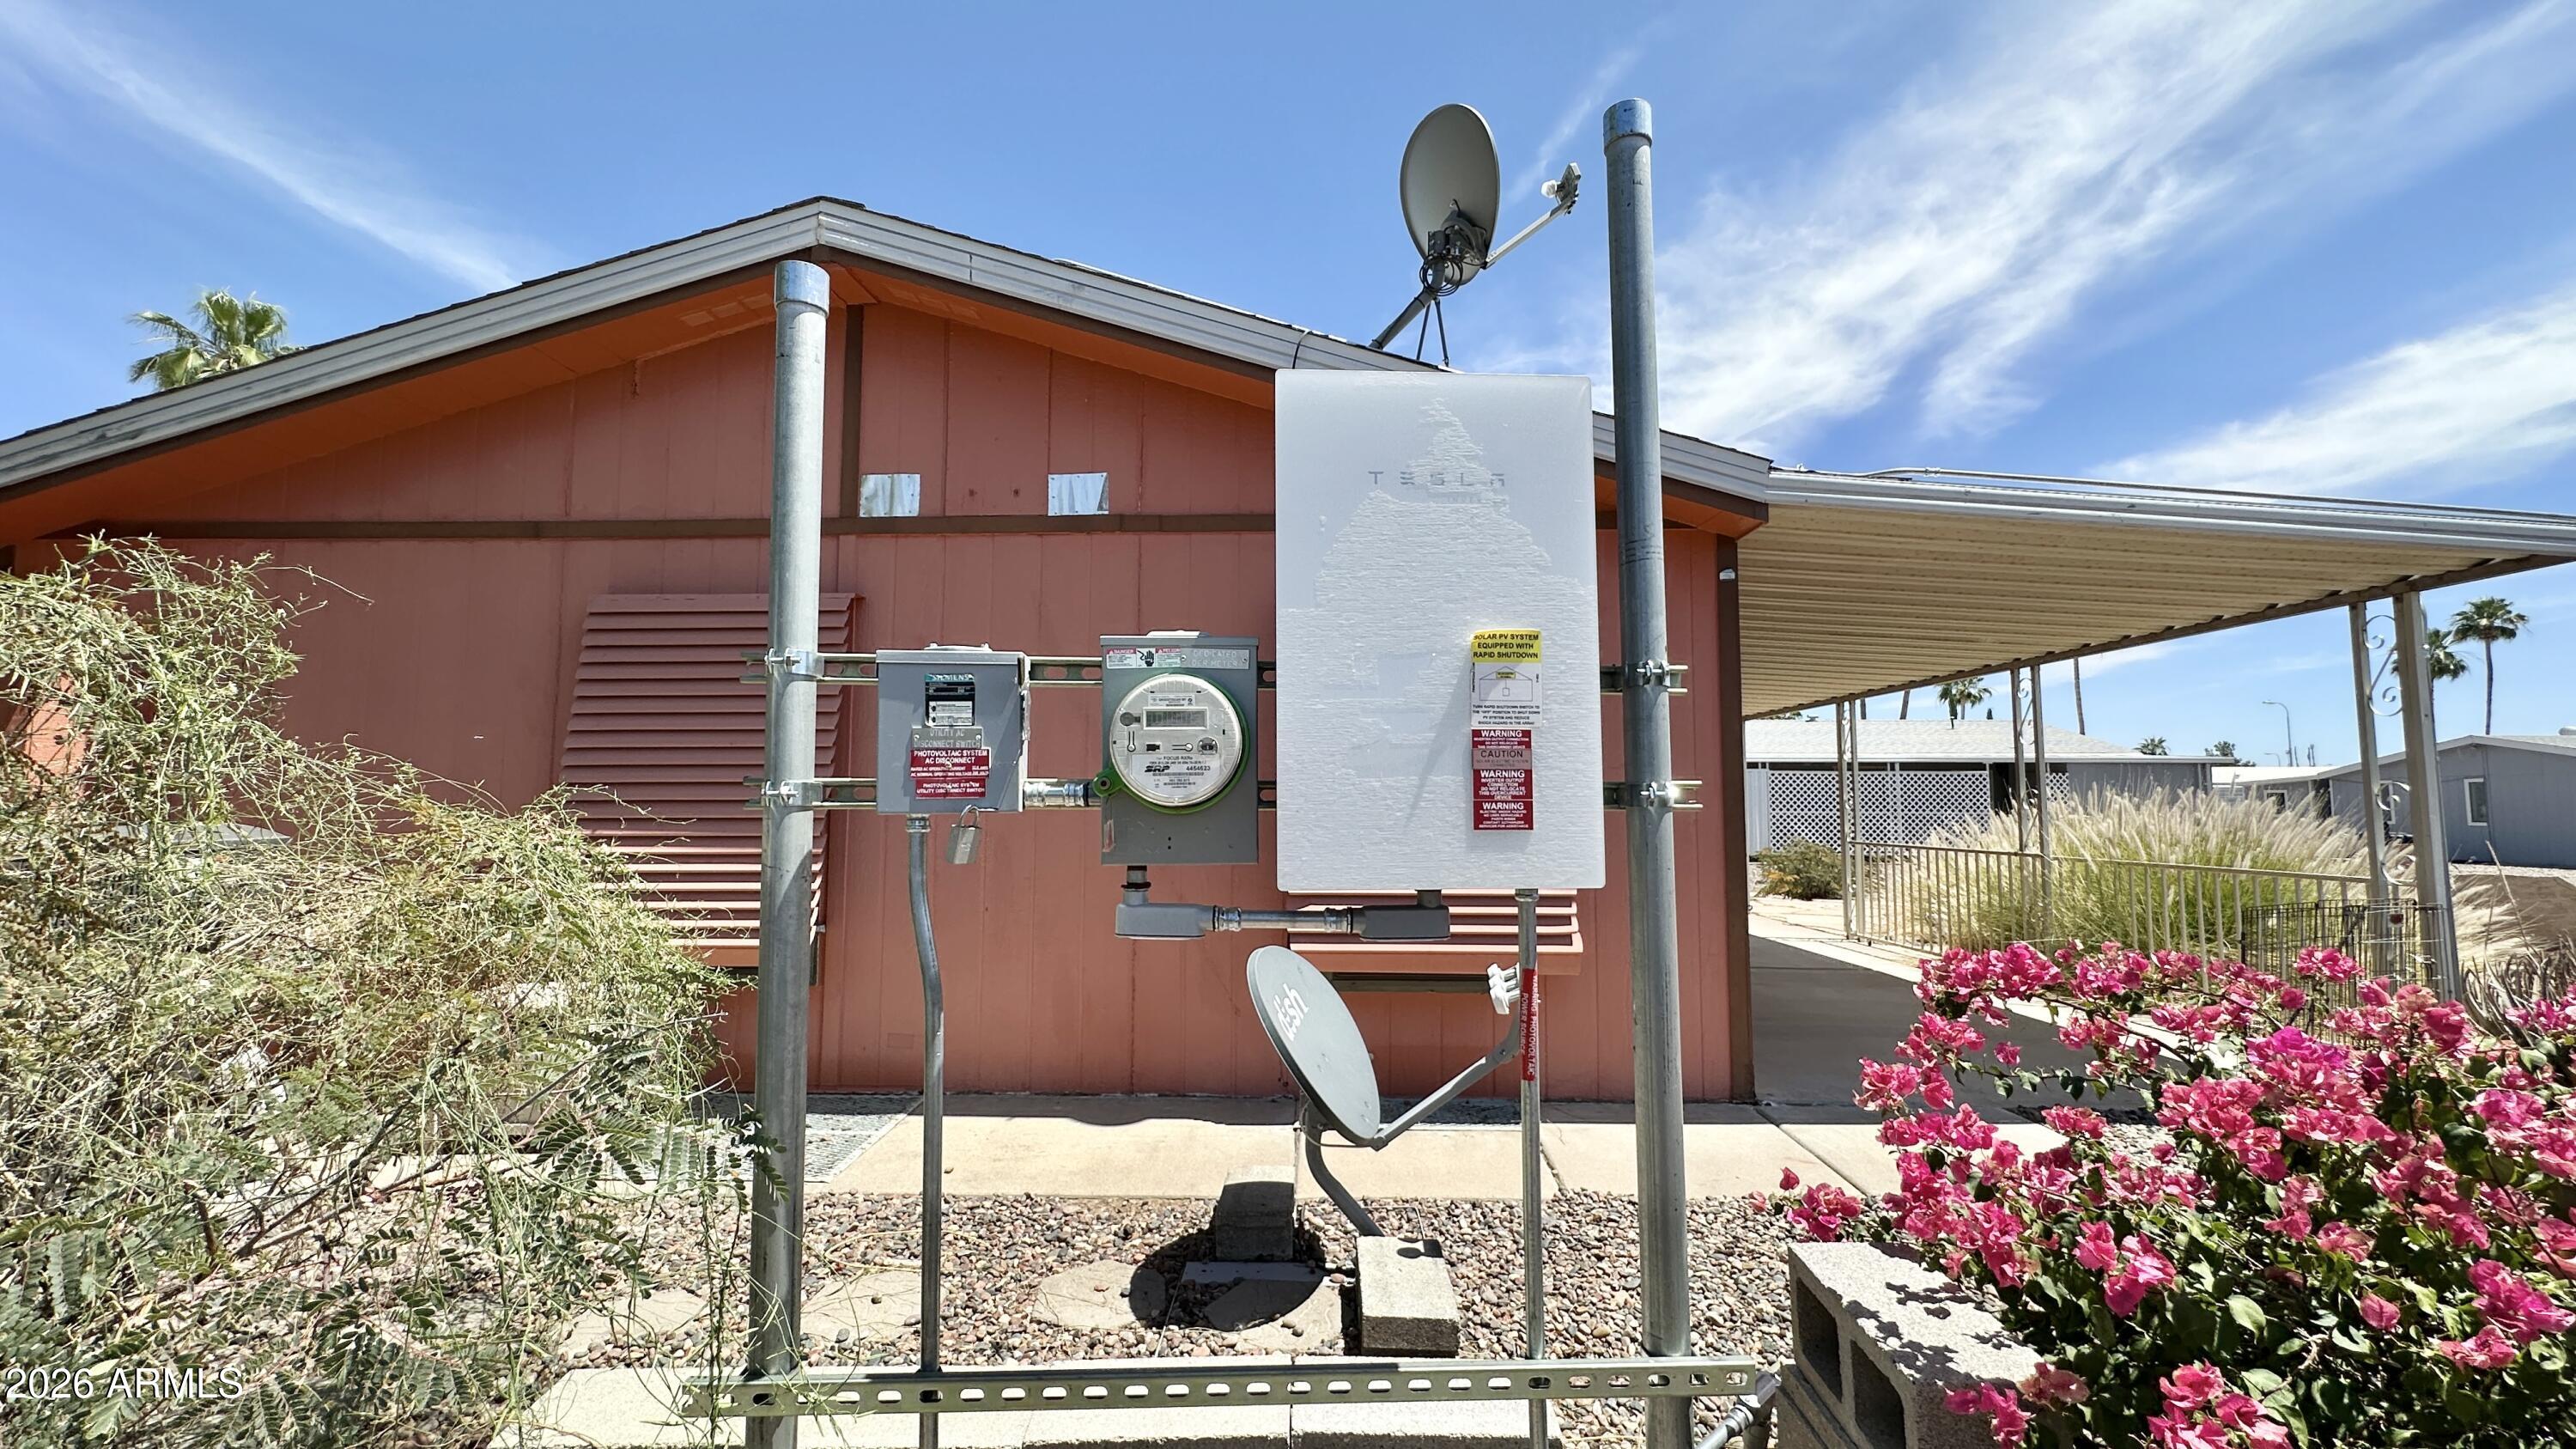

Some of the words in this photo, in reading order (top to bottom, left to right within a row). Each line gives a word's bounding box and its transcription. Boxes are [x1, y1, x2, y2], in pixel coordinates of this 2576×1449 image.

[1368, 471, 1505, 487] TESLA
[929, 728, 954, 737] UTILITY
[956, 728, 965, 737] AC
[1480, 729, 1522, 738] WARNING
[913, 740, 953, 748] DISCONNECT
[955, 740, 981, 748] SWITCH
[1479, 770, 1525, 778] WARNING
[1482, 801, 1524, 810] WARNING
[1273, 983, 1309, 1042] dish
[1528, 1016, 1537, 1076] PHOTOVOLTAIC
